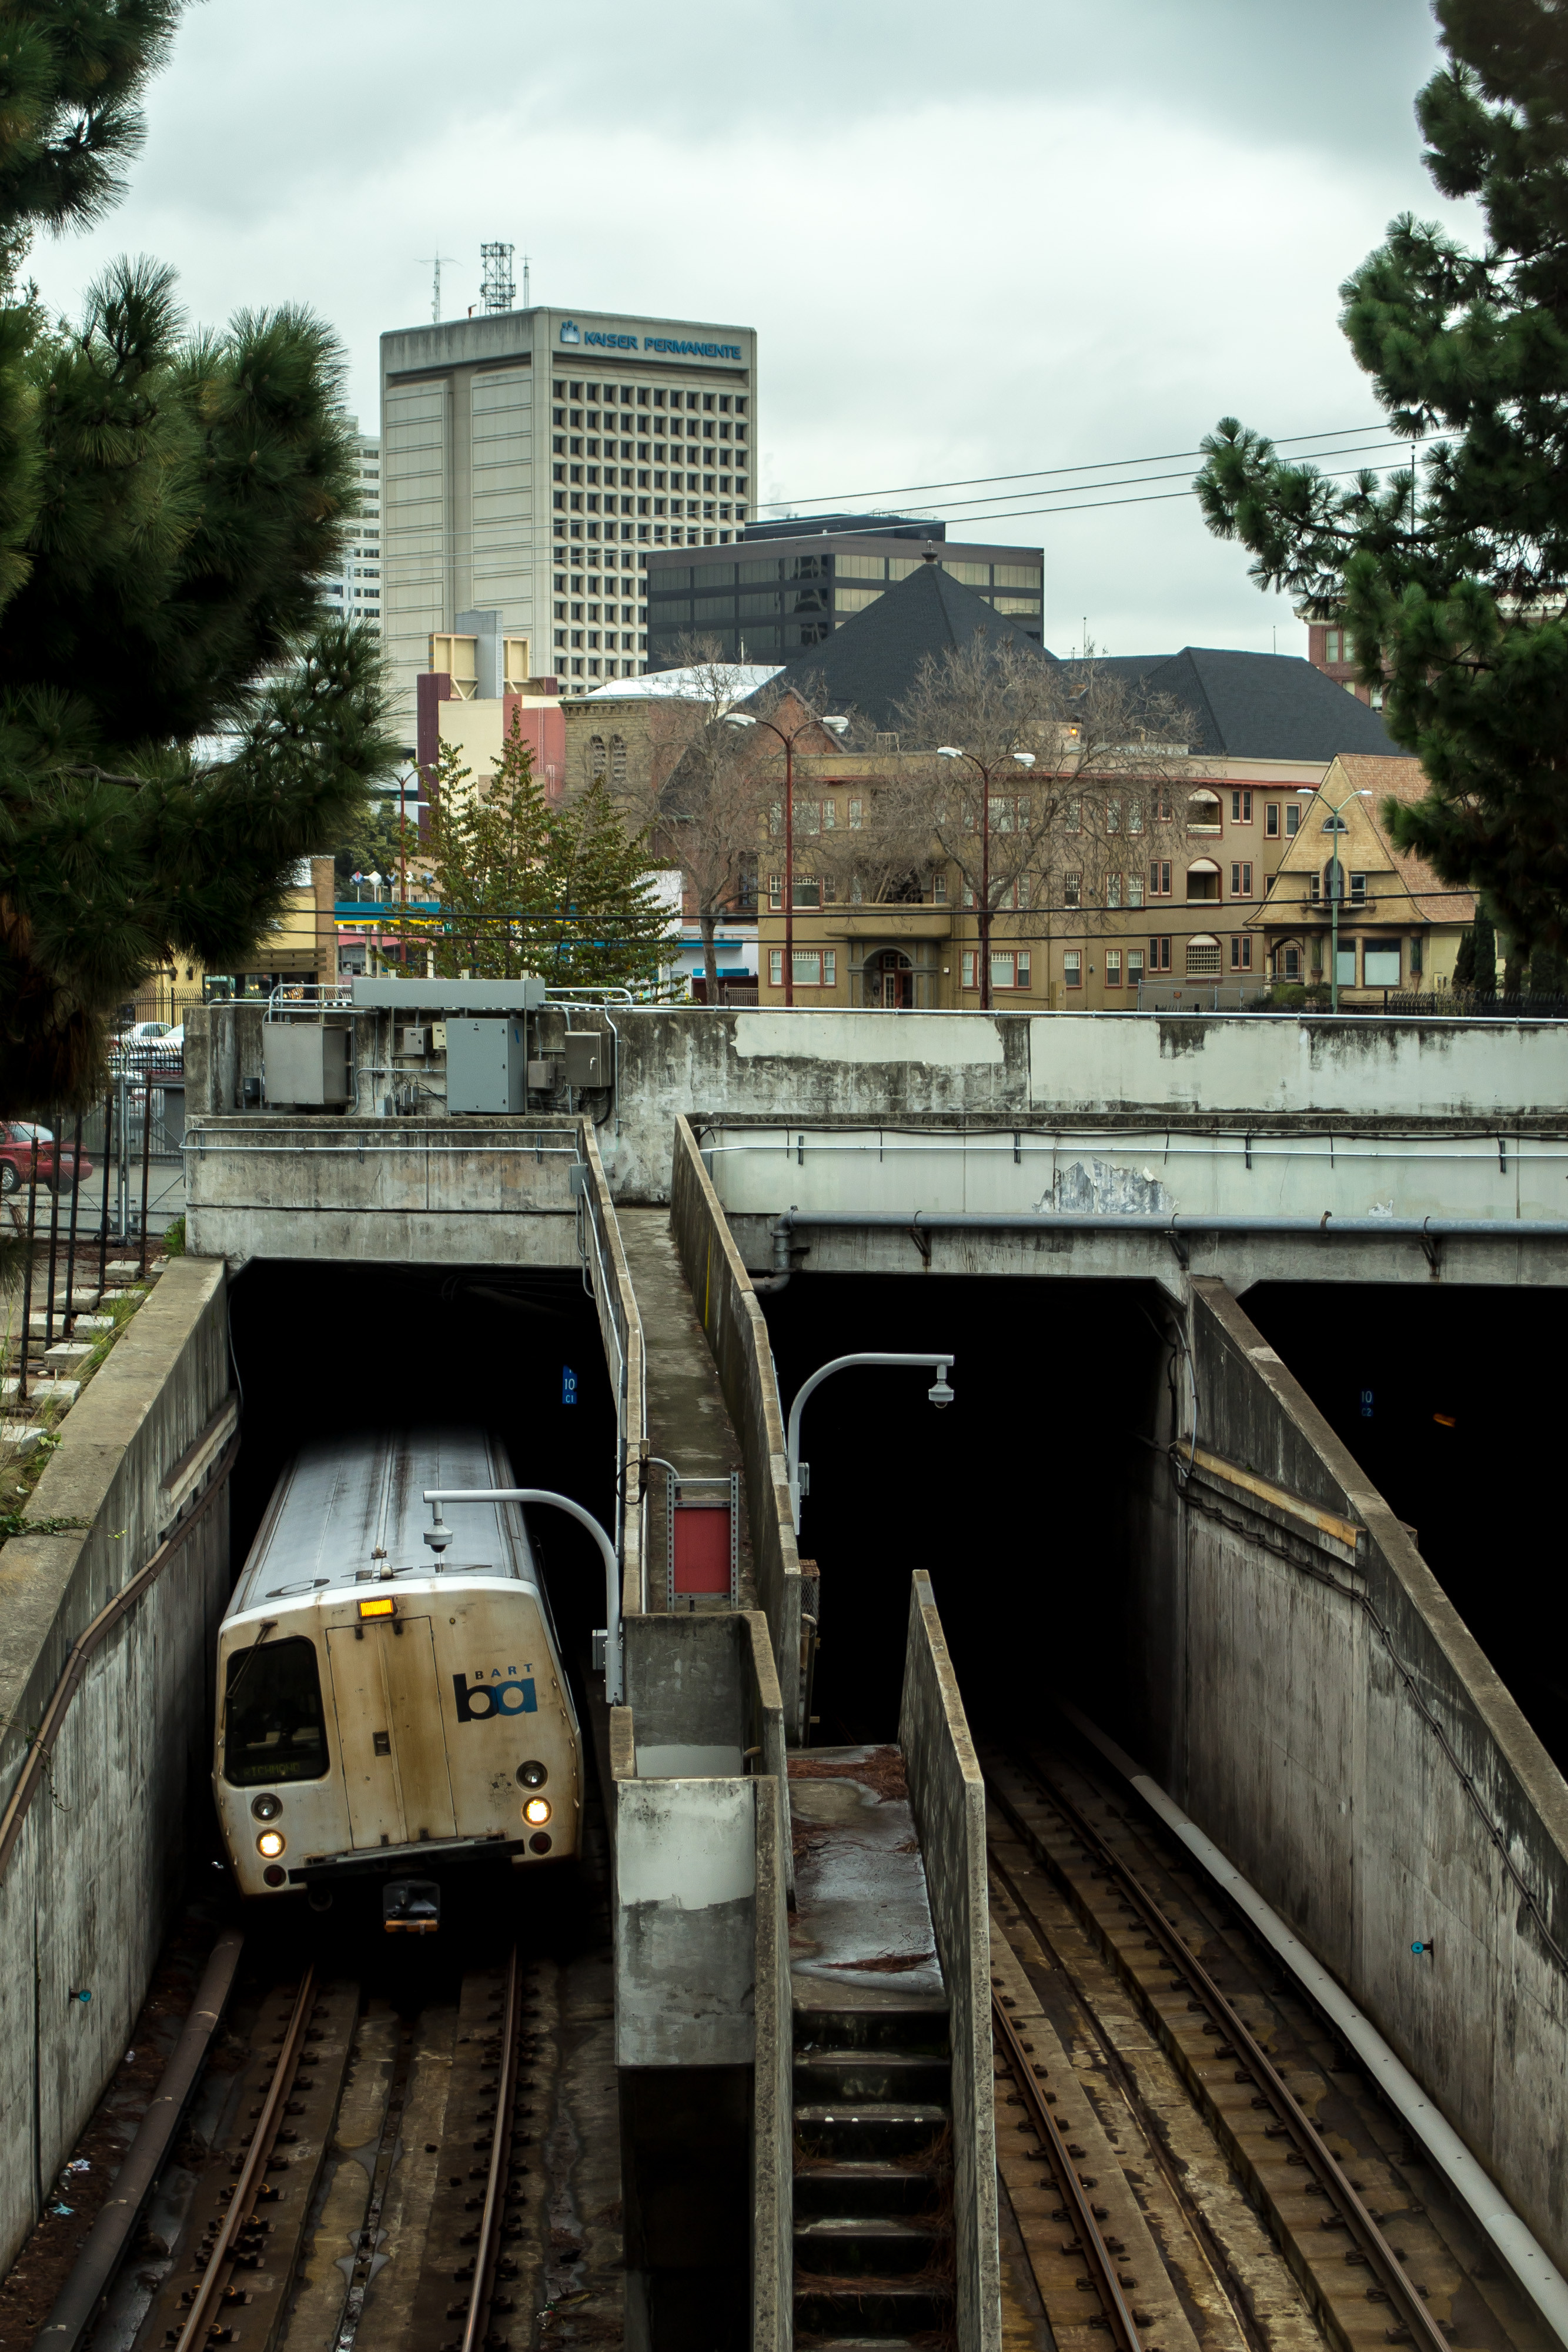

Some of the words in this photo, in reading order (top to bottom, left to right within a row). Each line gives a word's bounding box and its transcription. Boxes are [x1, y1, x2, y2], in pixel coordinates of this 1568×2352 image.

[584, 332, 638, 350] KAISER
[644, 336, 741, 359] PERMANENTE
[564, 1378, 575, 1390] 10
[1361, 1390, 1372, 1403] 10
[475, 1663, 533, 1680] BART
[453, 1673, 538, 1723] ba
[243, 1762, 301, 1778] RICHMOND
